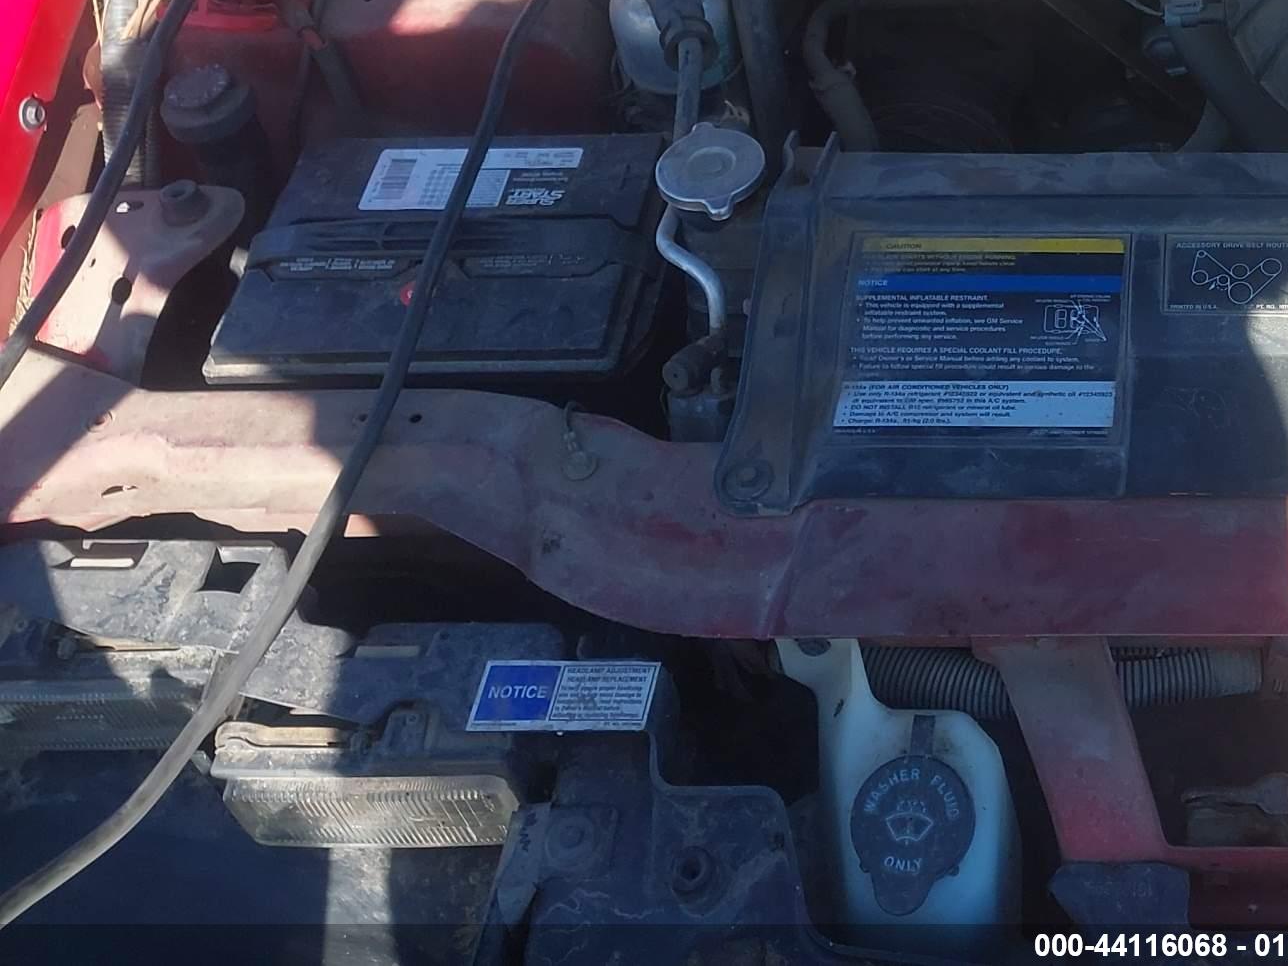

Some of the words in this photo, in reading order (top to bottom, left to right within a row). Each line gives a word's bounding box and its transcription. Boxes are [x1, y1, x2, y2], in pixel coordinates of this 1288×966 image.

[886, 242, 923, 250] CAUTION
[857, 279, 889, 287] NOTICE
[487, 684, 550, 699] NOTICE
[863, 767, 922, 813] WASHER
[929, 774, 961, 822] FLUID
[884, 855, 923, 873] ONLY
